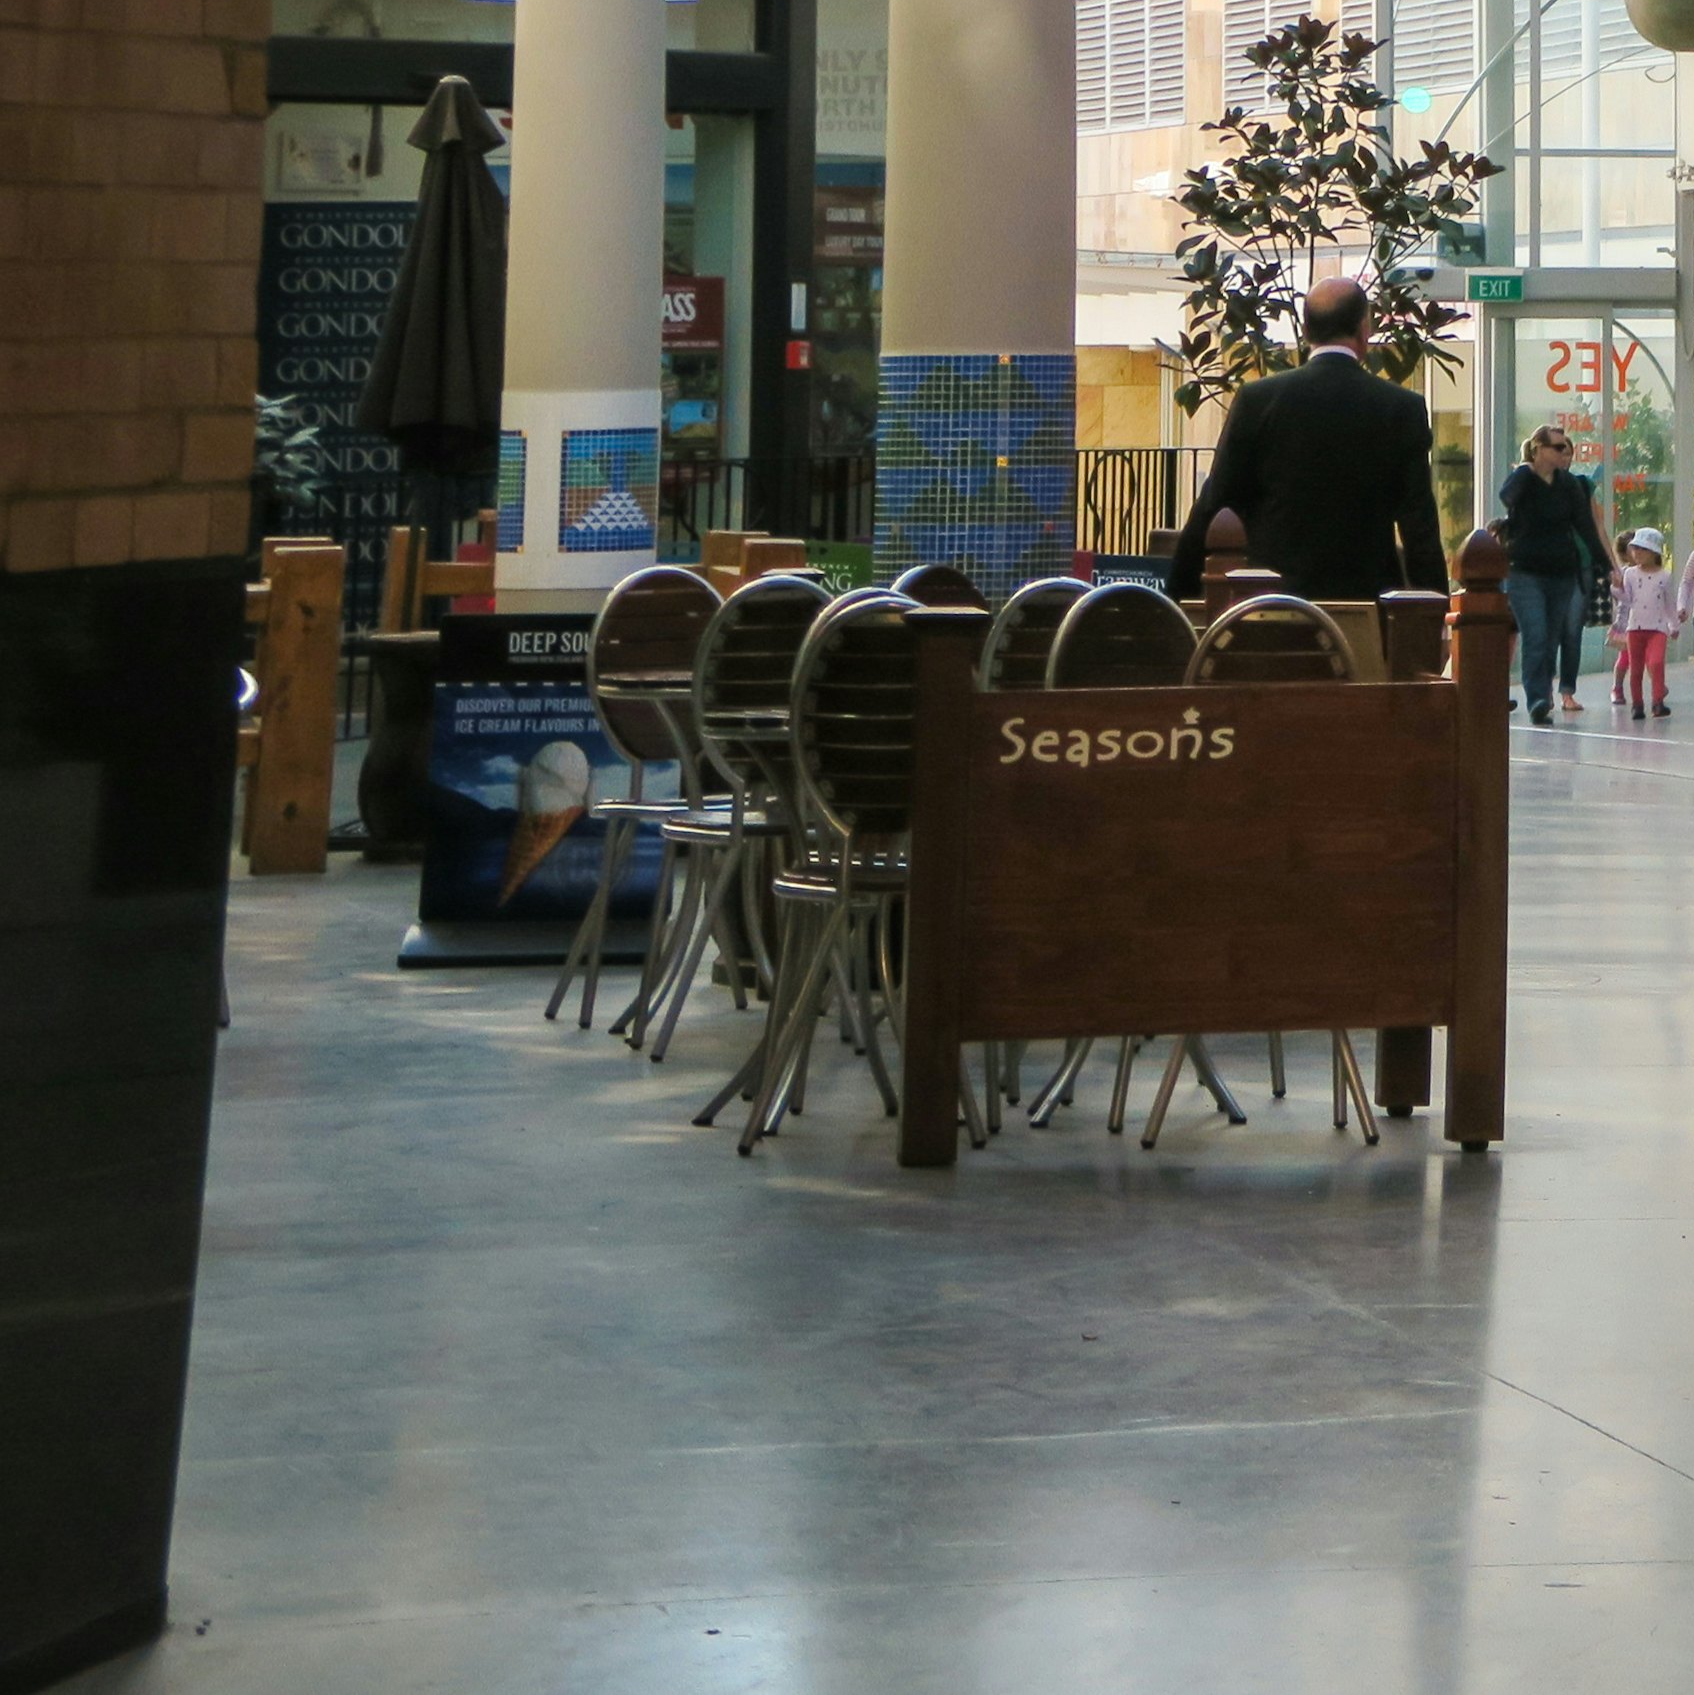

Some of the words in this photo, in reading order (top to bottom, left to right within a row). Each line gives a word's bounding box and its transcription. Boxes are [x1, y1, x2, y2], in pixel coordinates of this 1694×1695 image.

[1479, 280, 1511, 298] EXIT
[508, 632, 557, 654] DEEP
[456, 698, 515, 714] DISCOVER
[517, 699, 542, 713] OUR
[454, 718, 475, 734] ICE
[478, 718, 521, 733] CREAM
[523, 718, 585, 733] FLAVOURS
[999, 710, 1235, 768] Seasons
